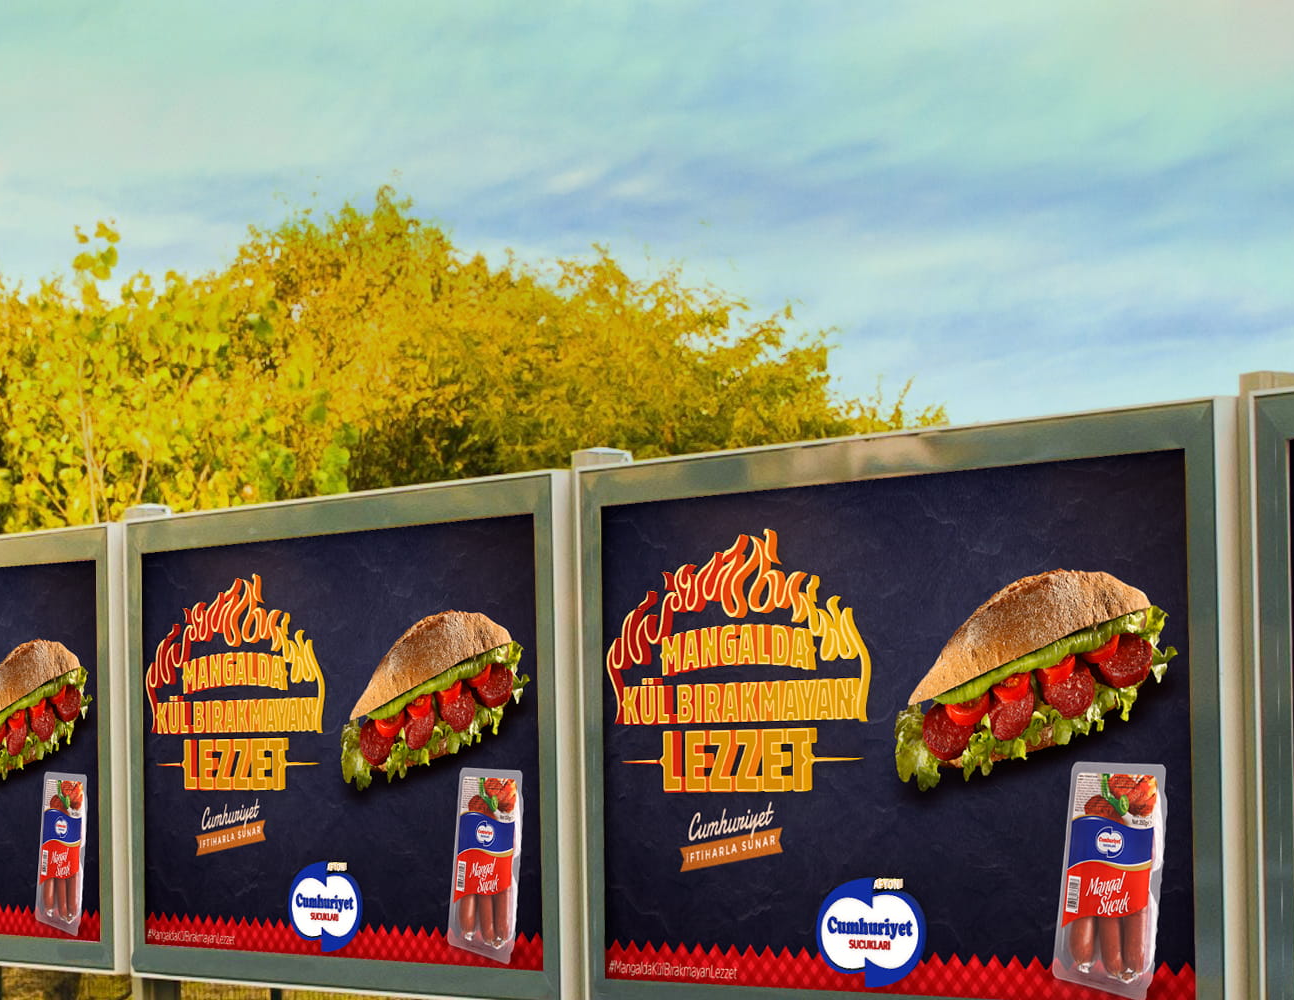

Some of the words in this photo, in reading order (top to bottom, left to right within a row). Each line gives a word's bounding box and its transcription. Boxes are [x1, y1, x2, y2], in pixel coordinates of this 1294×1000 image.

[660, 624, 816, 677] MANGALDA
[182, 652, 288, 694] MANGALDA
[156, 696, 192, 734] KÜL
[193, 697, 318, 733] BIRAKMAYAN
[622, 677, 673, 725] KÜL
[677, 678, 860, 724] BIRAKMAYAN
[182, 737, 289, 790] LEZZET
[659, 728, 817, 793] LEZZET
[201, 798, 260, 830] Cumhuriyet
[688, 801, 774, 841] Cumhuriyet
[741, 835, 776, 851] SUNAR
[469, 858, 496, 880] Mangal
[477, 876, 499, 894] Sucuk
[1085, 872, 1125, 899] Mangal
[295, 893, 354, 912] Cumhuriyet
[1097, 892, 1130, 916] Sucuk
[827, 916, 913, 938] Cumhuriyet
[848, 939, 891, 951] SUCUKLARI
